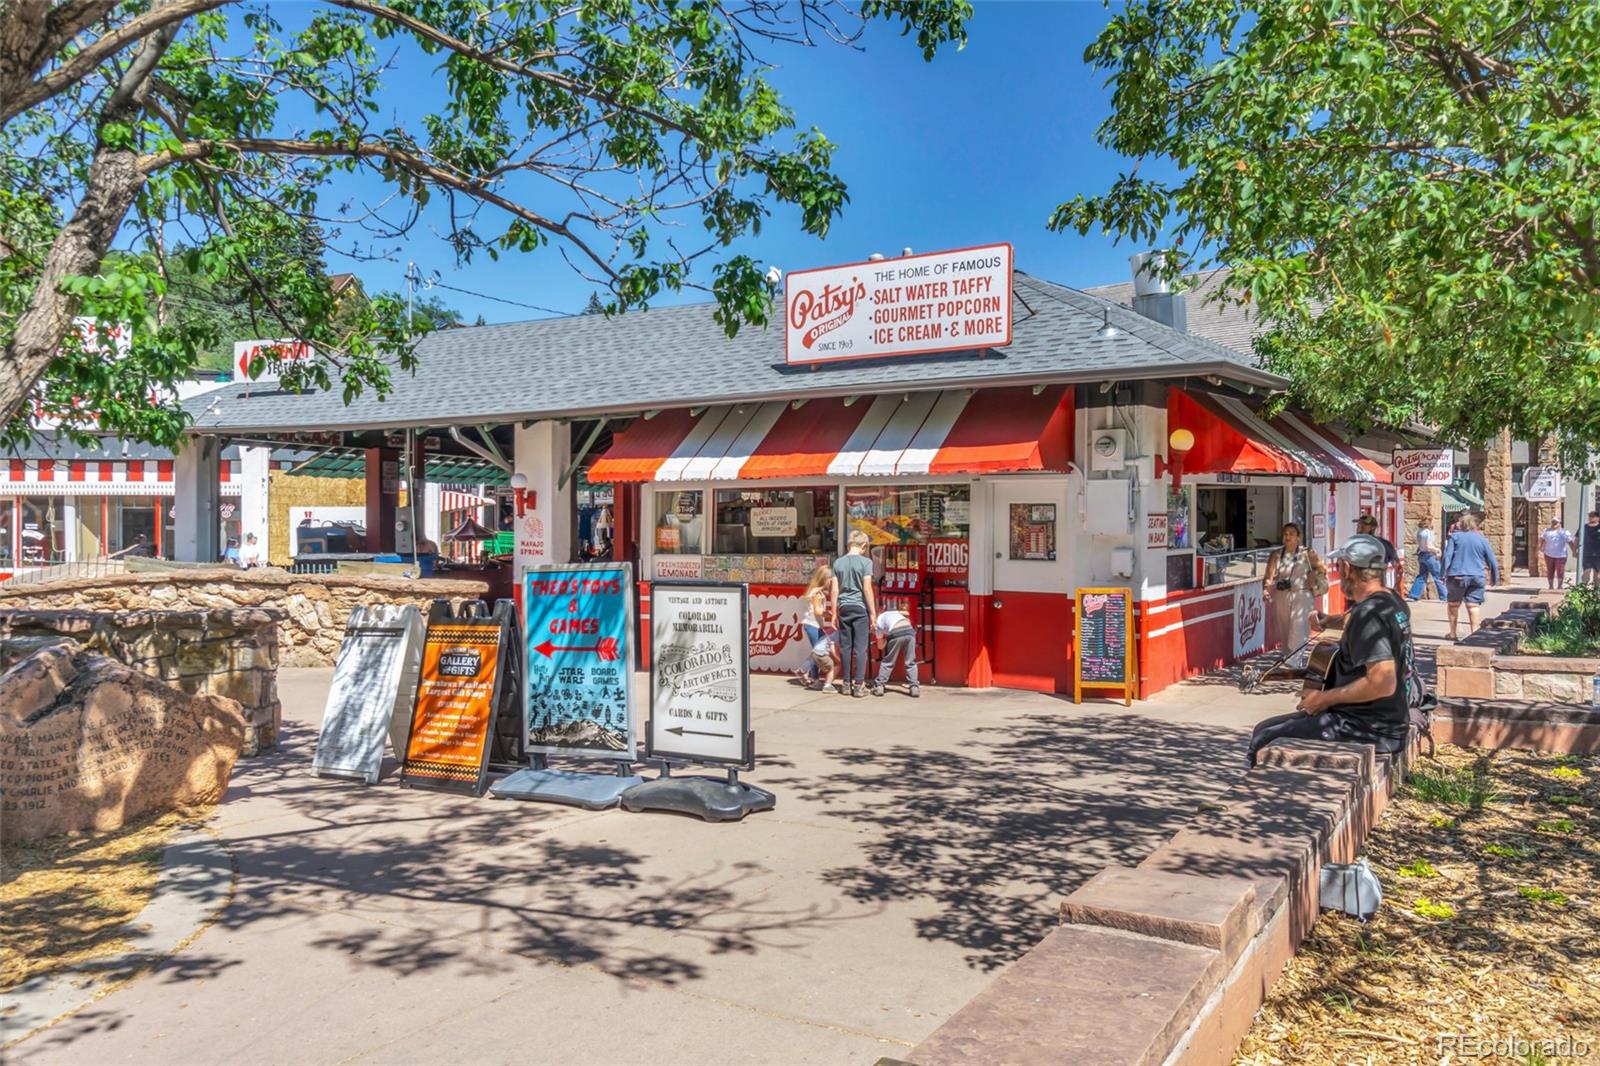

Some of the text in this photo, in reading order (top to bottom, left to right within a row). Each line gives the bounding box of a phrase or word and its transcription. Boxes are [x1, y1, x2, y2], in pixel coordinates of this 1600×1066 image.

[875, 256, 1001, 282] THE HOME OF FAMOUS
[874, 276, 992, 305] SALT WATER TAFFY
[790, 276, 867, 330] Patsy's
[874, 296, 1001, 325] GOURMET POPCORN
[810, 312, 851, 340] ORIGINAL
[874, 317, 1003, 345] ICE CREAM & MORE
[818, 342, 836, 352] SINCE
[1427, 453, 1450, 461] CANDY
[1405, 471, 1450, 481] GIFT SHOP
[927, 543, 969, 566] AZBOG
[657, 569, 699, 578] LEMONADE
[532, 579, 621, 596] THEO'S TOYS
[568, 599, 578, 613] &
[668, 597, 689, 605] VINTAGE
[705, 598, 728, 606] ANTIQUE
[678, 611, 717, 621] COLORADO
[1239, 594, 1261, 634] Patsy's
[550, 618, 599, 635] GAMES
[672, 622, 723, 634] MEMORABILIA
[749, 610, 803, 641] atsy's
[440, 656, 480, 666] GALLERY
[664, 651, 722, 677] COLORADO
[451, 666, 476, 675] GIFTS
[559, 667, 584, 676] STAR
[591, 667, 617, 676] BOARD
[560, 676, 585, 685] WARS
[593, 677, 619, 686] GAMES
[683, 667, 737, 690] ART OF FACTS
[669, 707, 693, 719] CARDS
[705, 711, 728, 722] GIFTS
[50, 742, 70, 754] ONE
[58, 778, 78, 793] AND
